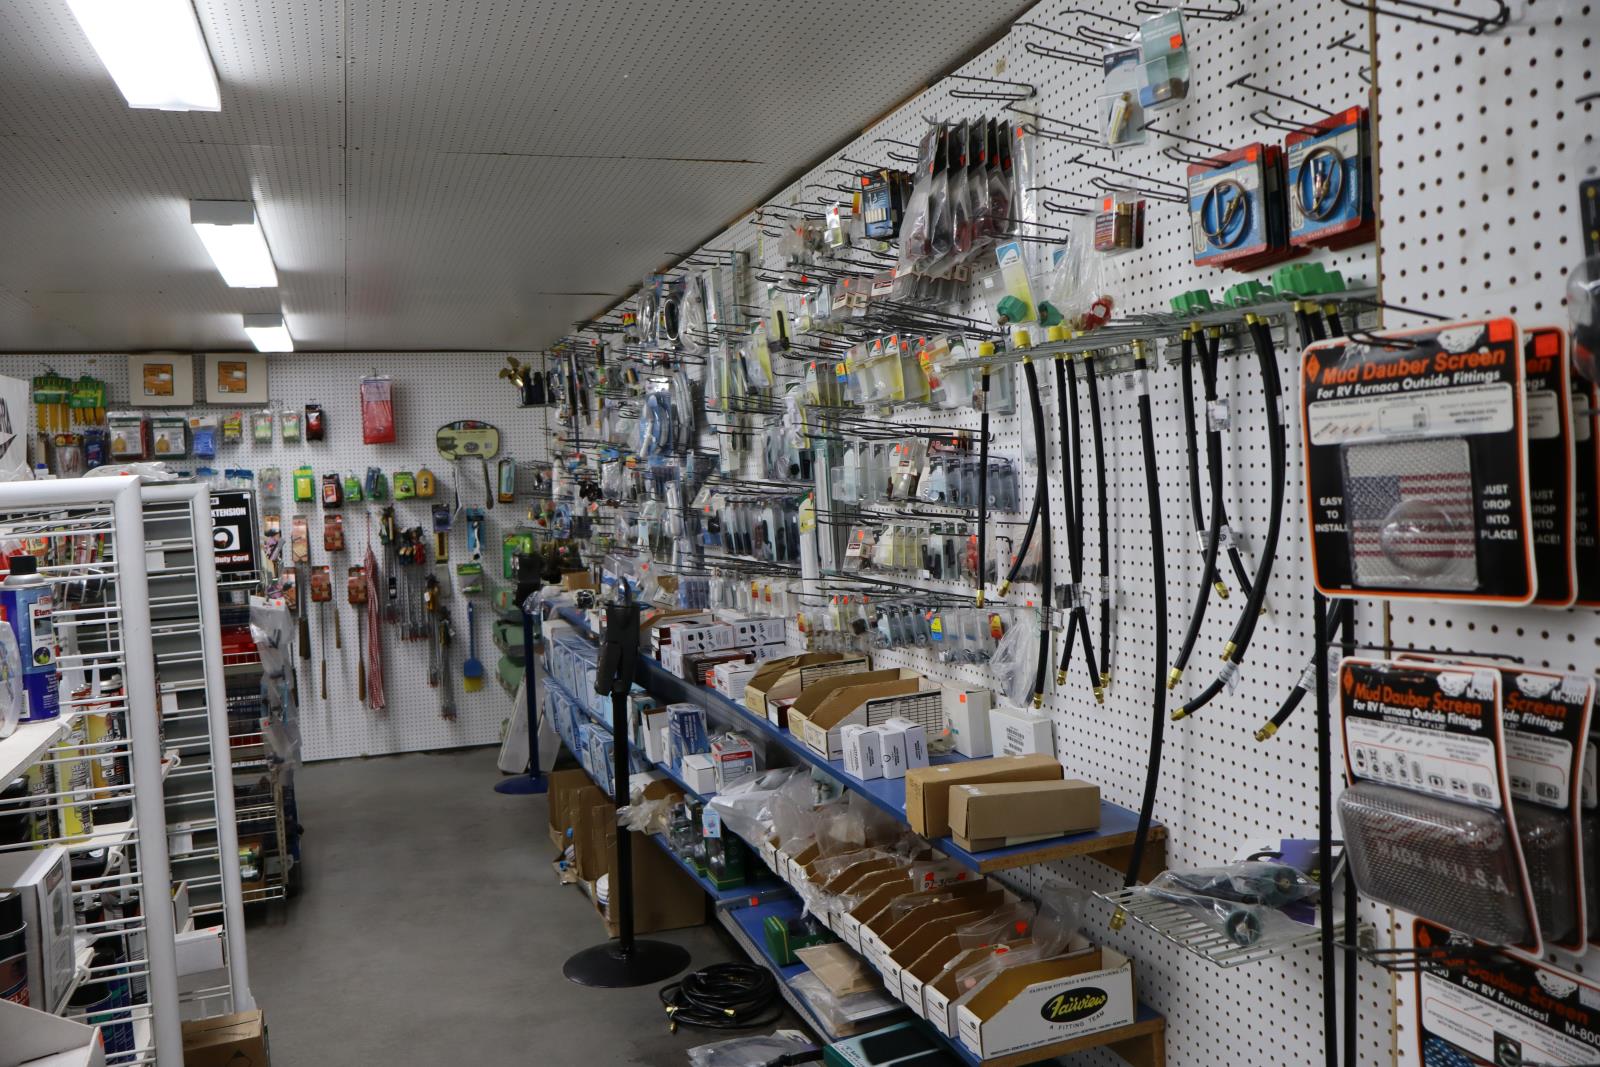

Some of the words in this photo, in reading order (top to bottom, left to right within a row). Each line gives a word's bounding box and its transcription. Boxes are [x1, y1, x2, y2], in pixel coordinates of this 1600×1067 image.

[1322, 362, 1358, 385] Mud
[1362, 357, 1430, 380] Dauber
[1434, 349, 1506, 371] Screen
[1316, 387, 1334, 400] For
[1336, 385, 1352, 398] RV
[1354, 381, 1400, 395] Furnace
[1402, 374, 1450, 389] Outside
[1453, 369, 1500, 385] Fittings
[1483, 484, 1509, 496] JUST
[1532, 489, 1554, 500] UST
[1320, 497, 1343, 506] EASY
[1483, 500, 1511, 511] DROP
[210, 507, 247, 518] XTENSION
[1326, 510, 1339, 519] TO
[1486, 514, 1510, 525] INTO
[1480, 529, 1518, 540] PLACE!
[1354, 683, 1380, 701] Mud
[1383, 686, 1430, 708] Dauber
[1433, 692, 1482, 715] Screen
[1506, 691, 1568, 718] Screen
[1353, 699, 1366, 711] For
[1367, 701, 1378, 712] RV
[1379, 703, 1411, 718] Furnace
[1412, 708, 1446, 723] Outside
[1447, 713, 1483, 731] Fittings
[1522, 713, 1564, 732] Fittings
[1048, 994, 1106, 1019] Fairview
[1462, 975, 1480, 991] For
[1481, 984, 1497, 998] RV
[1498, 991, 1549, 1023] Furnaces!
[1529, 986, 1589, 1025] Screen
[1058, 1021, 1085, 1031] FITTING
[1088, 1010, 1105, 1023] TEAM
[1565, 1021, 1600, 1046] M-800
